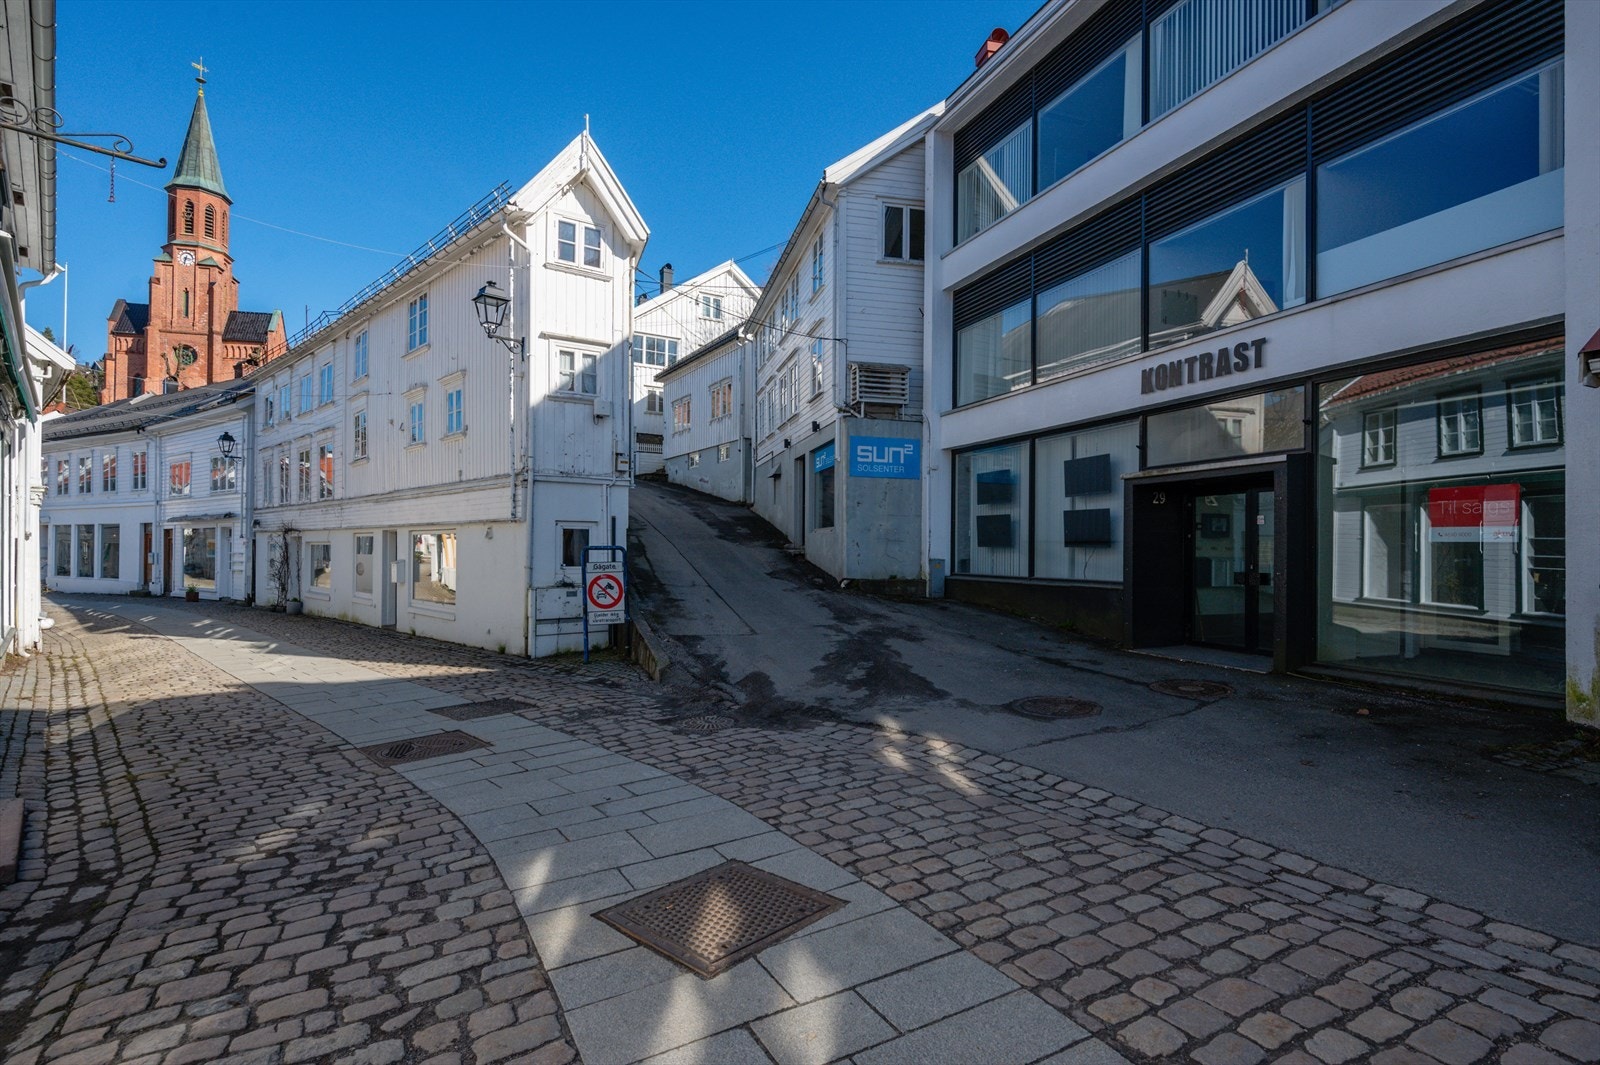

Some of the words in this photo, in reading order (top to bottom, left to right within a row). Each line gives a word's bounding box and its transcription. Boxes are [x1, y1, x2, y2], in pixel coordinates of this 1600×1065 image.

[1141, 338, 1266, 394] KONTRAST
[857, 464, 905, 473] SOLSENTER
[1152, 491, 1166, 504] 29
[1440, 500, 1457, 515] Til
